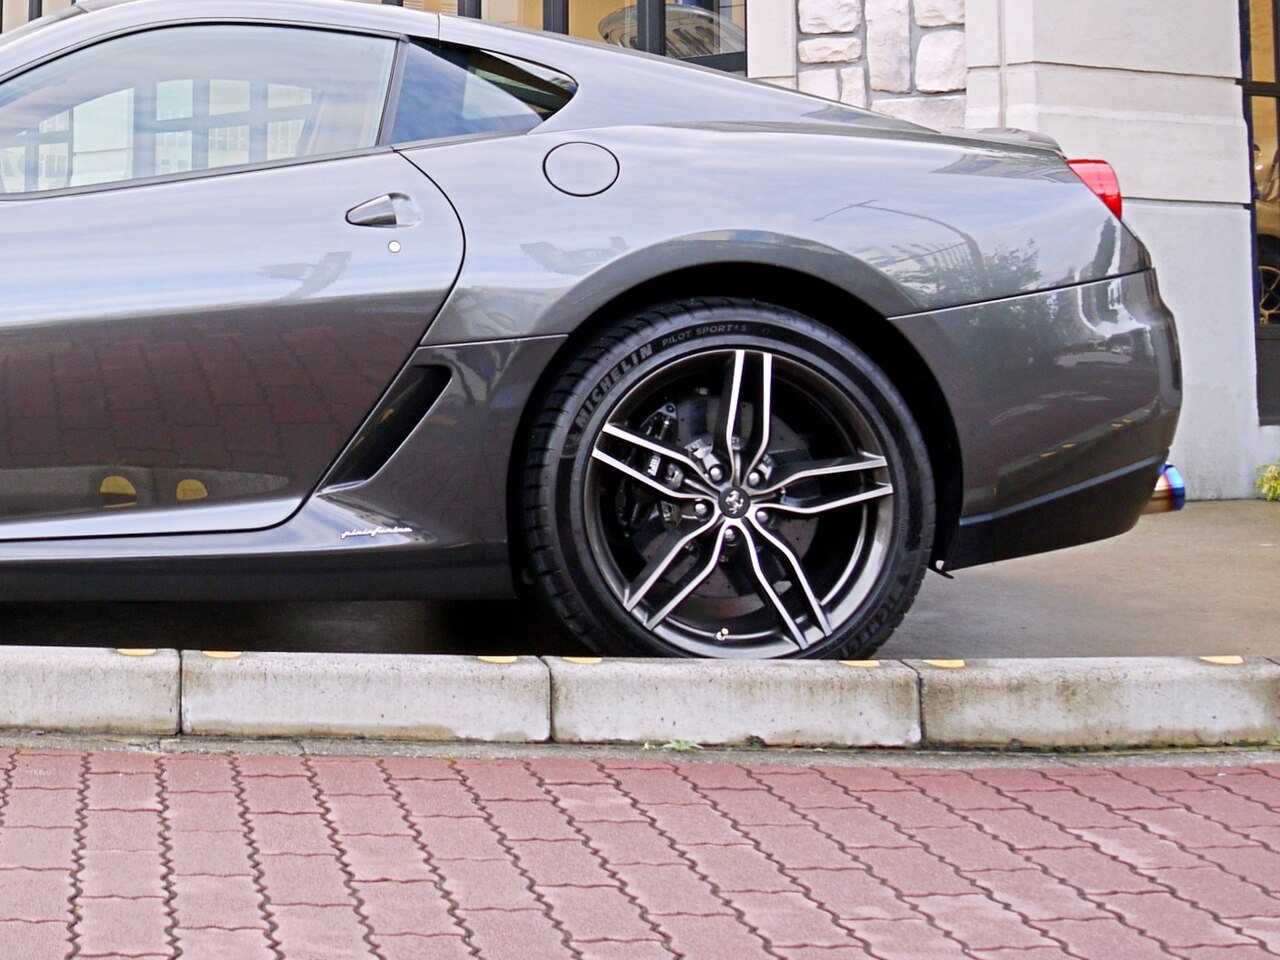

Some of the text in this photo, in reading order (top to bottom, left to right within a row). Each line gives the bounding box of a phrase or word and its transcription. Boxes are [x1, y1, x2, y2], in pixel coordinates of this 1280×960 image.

[575, 345, 653, 428] MICHELIN
[662, 330, 693, 346] PILOT
[696, 324, 733, 336] SPORT
